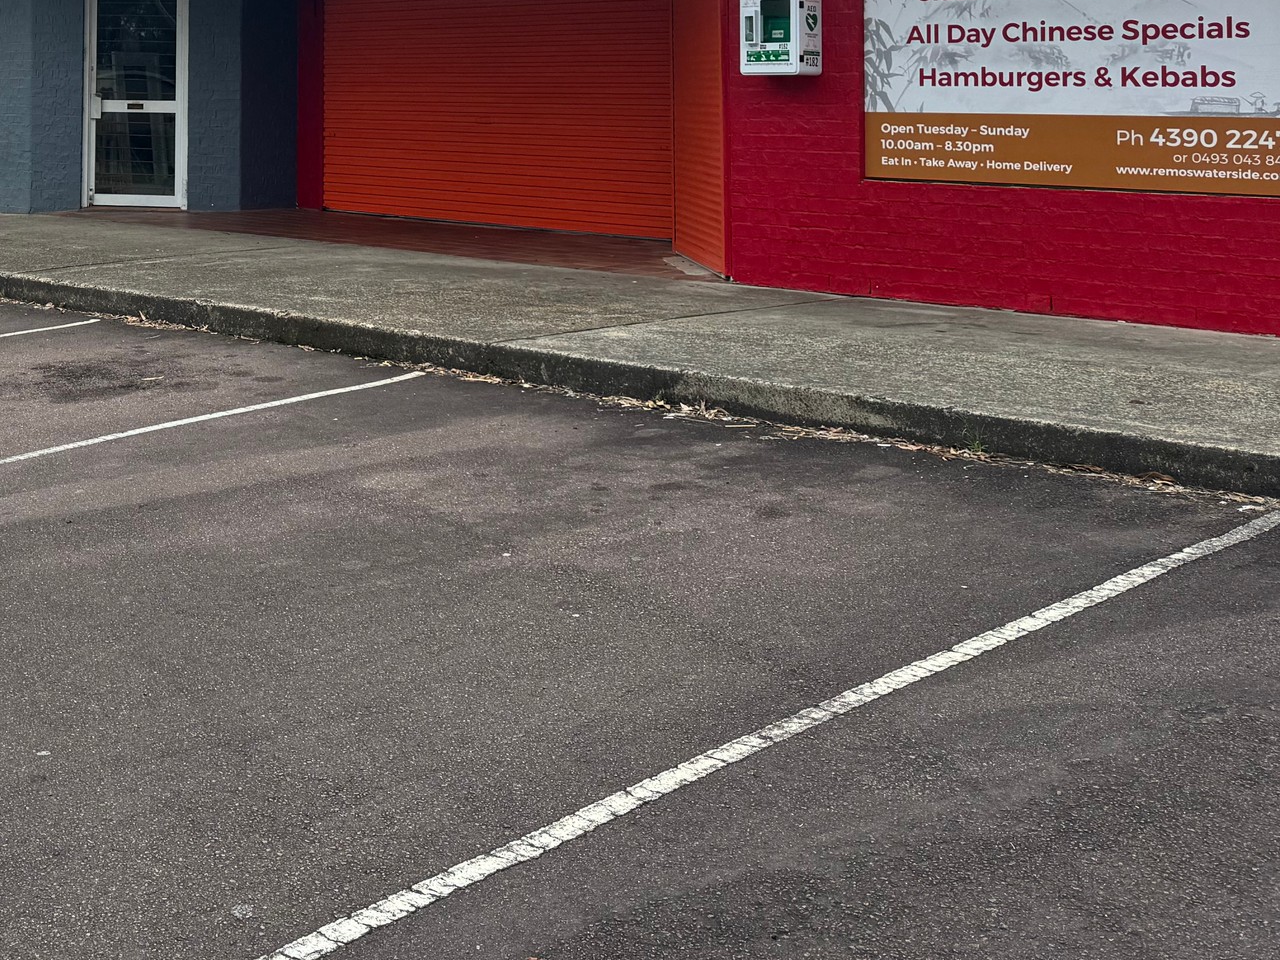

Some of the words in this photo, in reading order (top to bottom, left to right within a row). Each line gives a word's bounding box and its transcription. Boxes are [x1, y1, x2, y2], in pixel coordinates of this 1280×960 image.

[806, 5, 817, 13] AED
[906, 24, 939, 45] All
[947, 24, 996, 48] Day
[1002, 20, 1115, 43] Chinese
[1121, 16, 1251, 46] Specials
[805, 56, 819, 67] #182
[919, 66, 1087, 92] Hamburgers
[1094, 66, 1113, 88] &
[1121, 65, 1237, 88] Kebabs
[880, 123, 914, 136] Open
[916, 123, 969, 137] Tuesday
[979, 125, 1030, 139] Sunday
[1116, 129, 1144, 146] Ph
[1149, 127, 1218, 148] 4390
[1225, 129, 1280, 150] 224
[880, 139, 934, 151] 10.00am
[944, 141, 995, 154] 8.30pm
[881, 156, 899, 166] Eat
[901, 157, 912, 166] In
[919, 157, 945, 167] Take
[947, 159, 978, 170] Away
[986, 160, 1021, 170] Home
[1023, 161, 1073, 174] Delivery
[1173, 153, 1188, 163] or
[1191, 152, 1229, 165] 0493
[1232, 153, 1261, 166] 043
